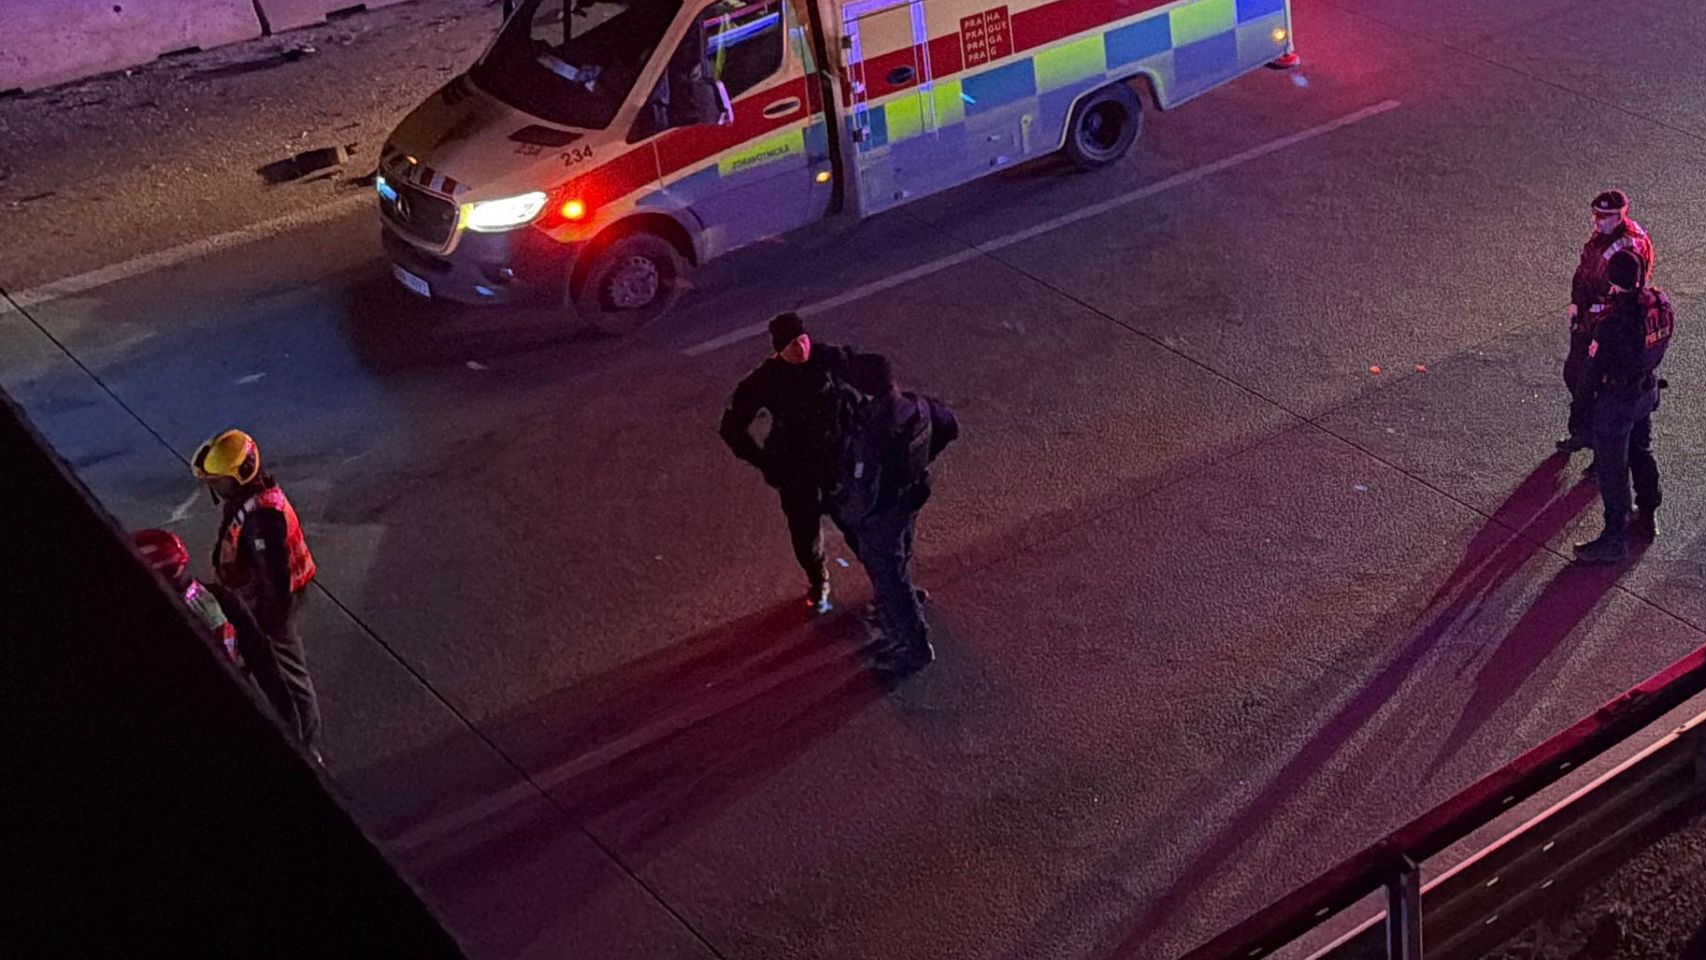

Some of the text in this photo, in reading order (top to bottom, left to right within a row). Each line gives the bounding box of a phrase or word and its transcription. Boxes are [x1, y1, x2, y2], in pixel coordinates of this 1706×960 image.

[964, 18, 982, 29] PRA
[965, 29, 984, 40] PRA
[967, 40, 985, 52] PRA
[968, 51, 986, 63] PRA
[560, 144, 593, 167] 234
